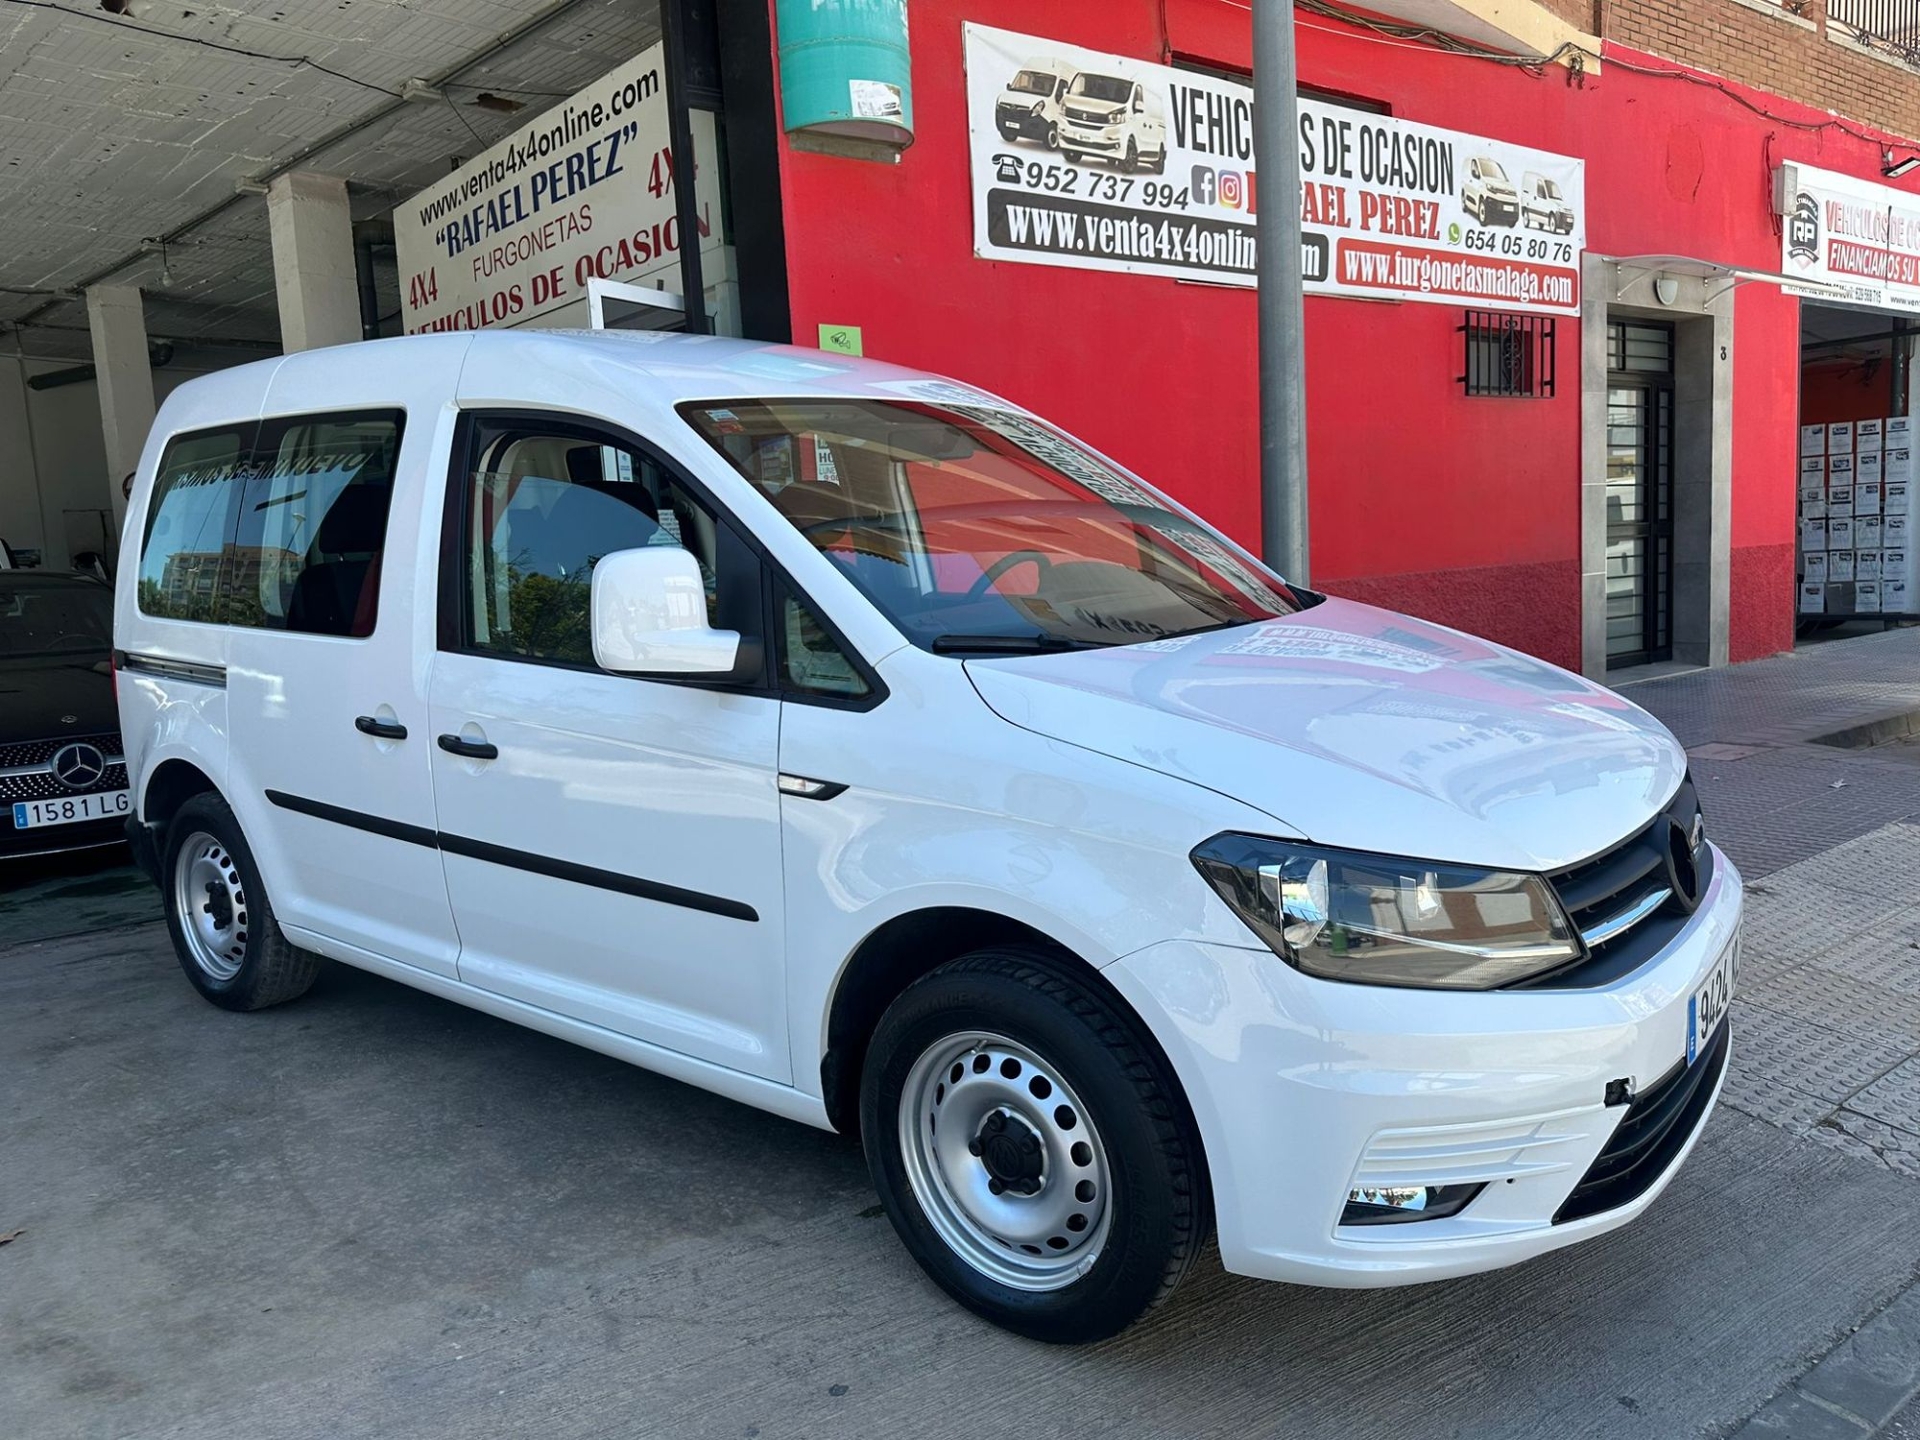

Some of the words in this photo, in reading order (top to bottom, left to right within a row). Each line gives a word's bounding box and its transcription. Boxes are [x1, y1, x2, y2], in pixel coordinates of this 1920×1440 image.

[420, 68, 660, 227] www.venta4x4online.com
[1169, 83, 1315, 172] VEHICS
[1322, 117, 1352, 179] DE
[1360, 125, 1454, 196] OCASION
[1026, 162, 1079, 194] 952
[1088, 172, 1135, 202] 737
[1142, 182, 1189, 211] 994
[1359, 190, 1441, 240] PEREZ
[473, 204, 593, 282] FURGONETAS
[1465, 228, 1496, 252] 654
[1501, 234, 1523, 256] 05
[1527, 239, 1547, 260] 80
[1553, 242, 1572, 262] 76
[1829, 242, 1900, 280] FINANCIAMOS
[1901, 257, 1915, 282] SU
[409, 266, 438, 311] 4X4
[532, 265, 567, 306] DE
[1344, 249, 1573, 304] www.furgonetasmalaga.com
[32, 798, 89, 823] 1581
[1700, 958, 1728, 1040] 9424
